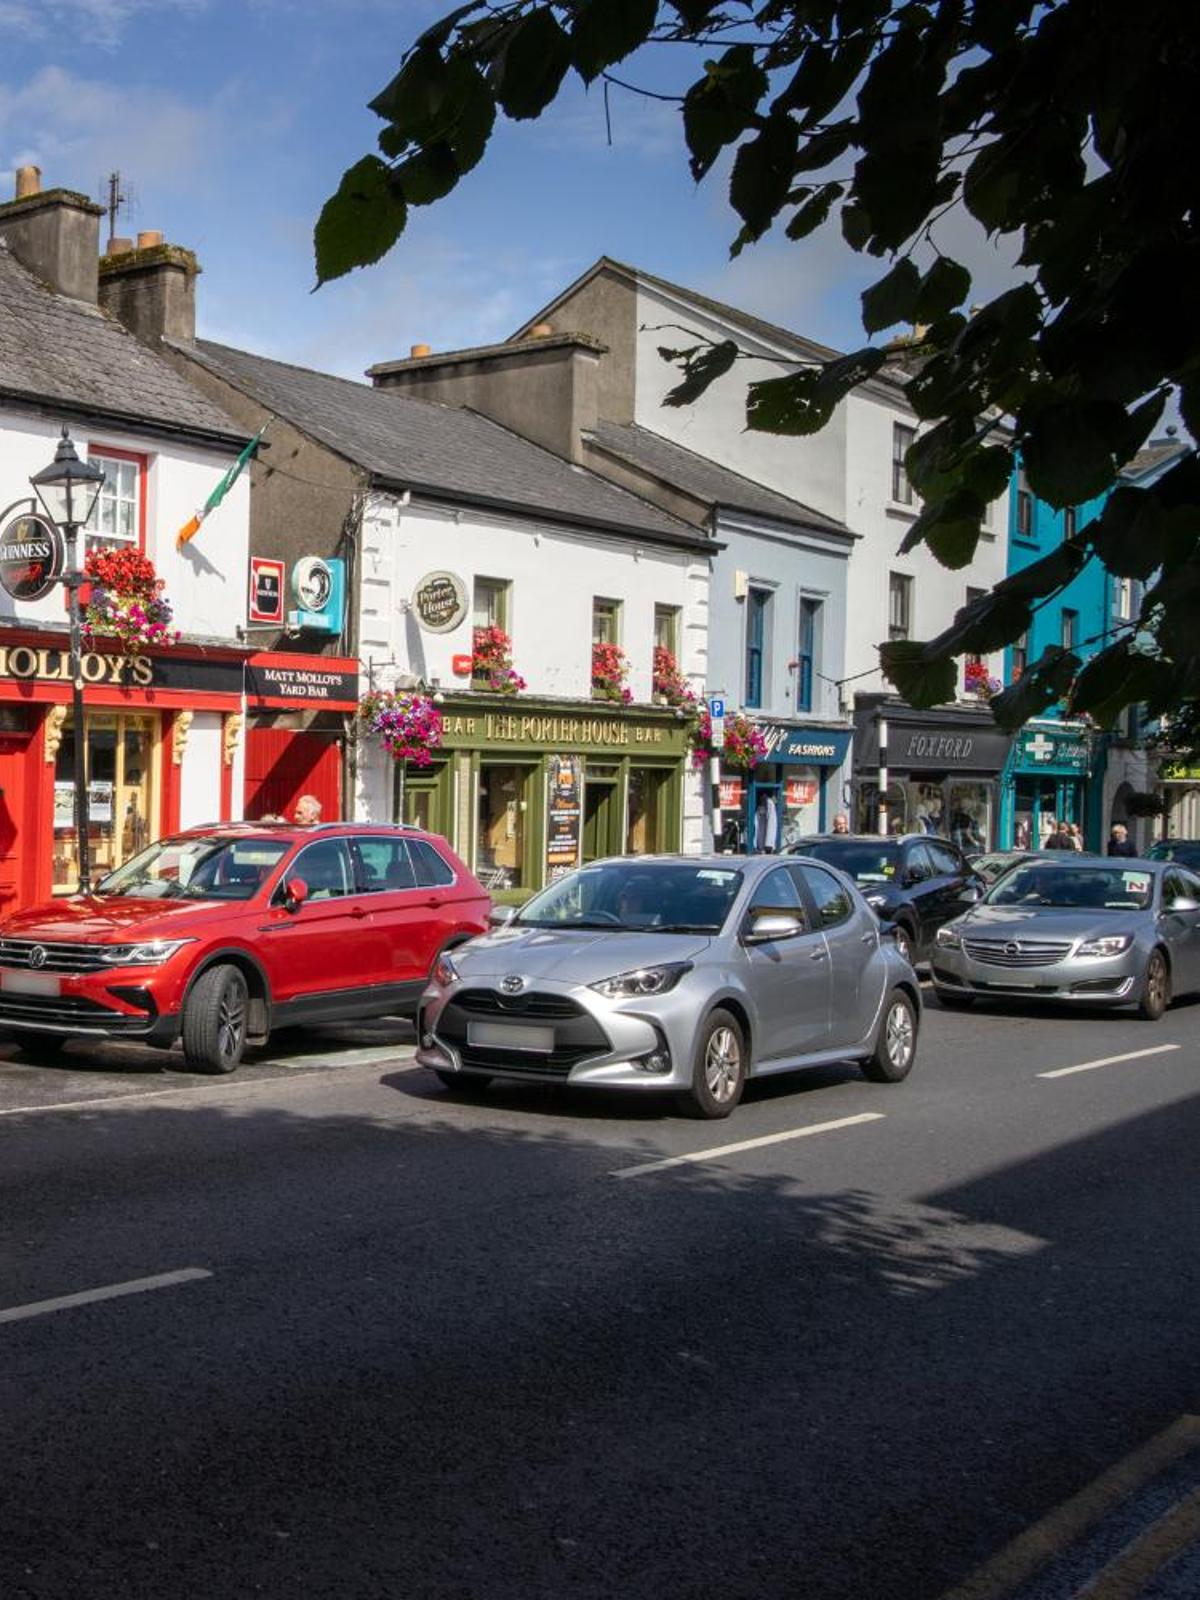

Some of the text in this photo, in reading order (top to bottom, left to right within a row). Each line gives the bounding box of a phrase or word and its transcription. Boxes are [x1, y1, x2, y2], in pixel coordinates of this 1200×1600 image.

[0, 542, 50, 560] GUINNESS
[264, 669, 295, 682] MATT
[280, 683, 329, 697] YARD BAR
[714, 702, 723, 716] P
[442, 716, 475, 733] BAR
[484, 713, 629, 745] THE PORTER HOUSE
[636, 727, 662, 742] BAR
[788, 743, 836, 757] FASHIONS
[906, 734, 974, 758] FOXFORD
